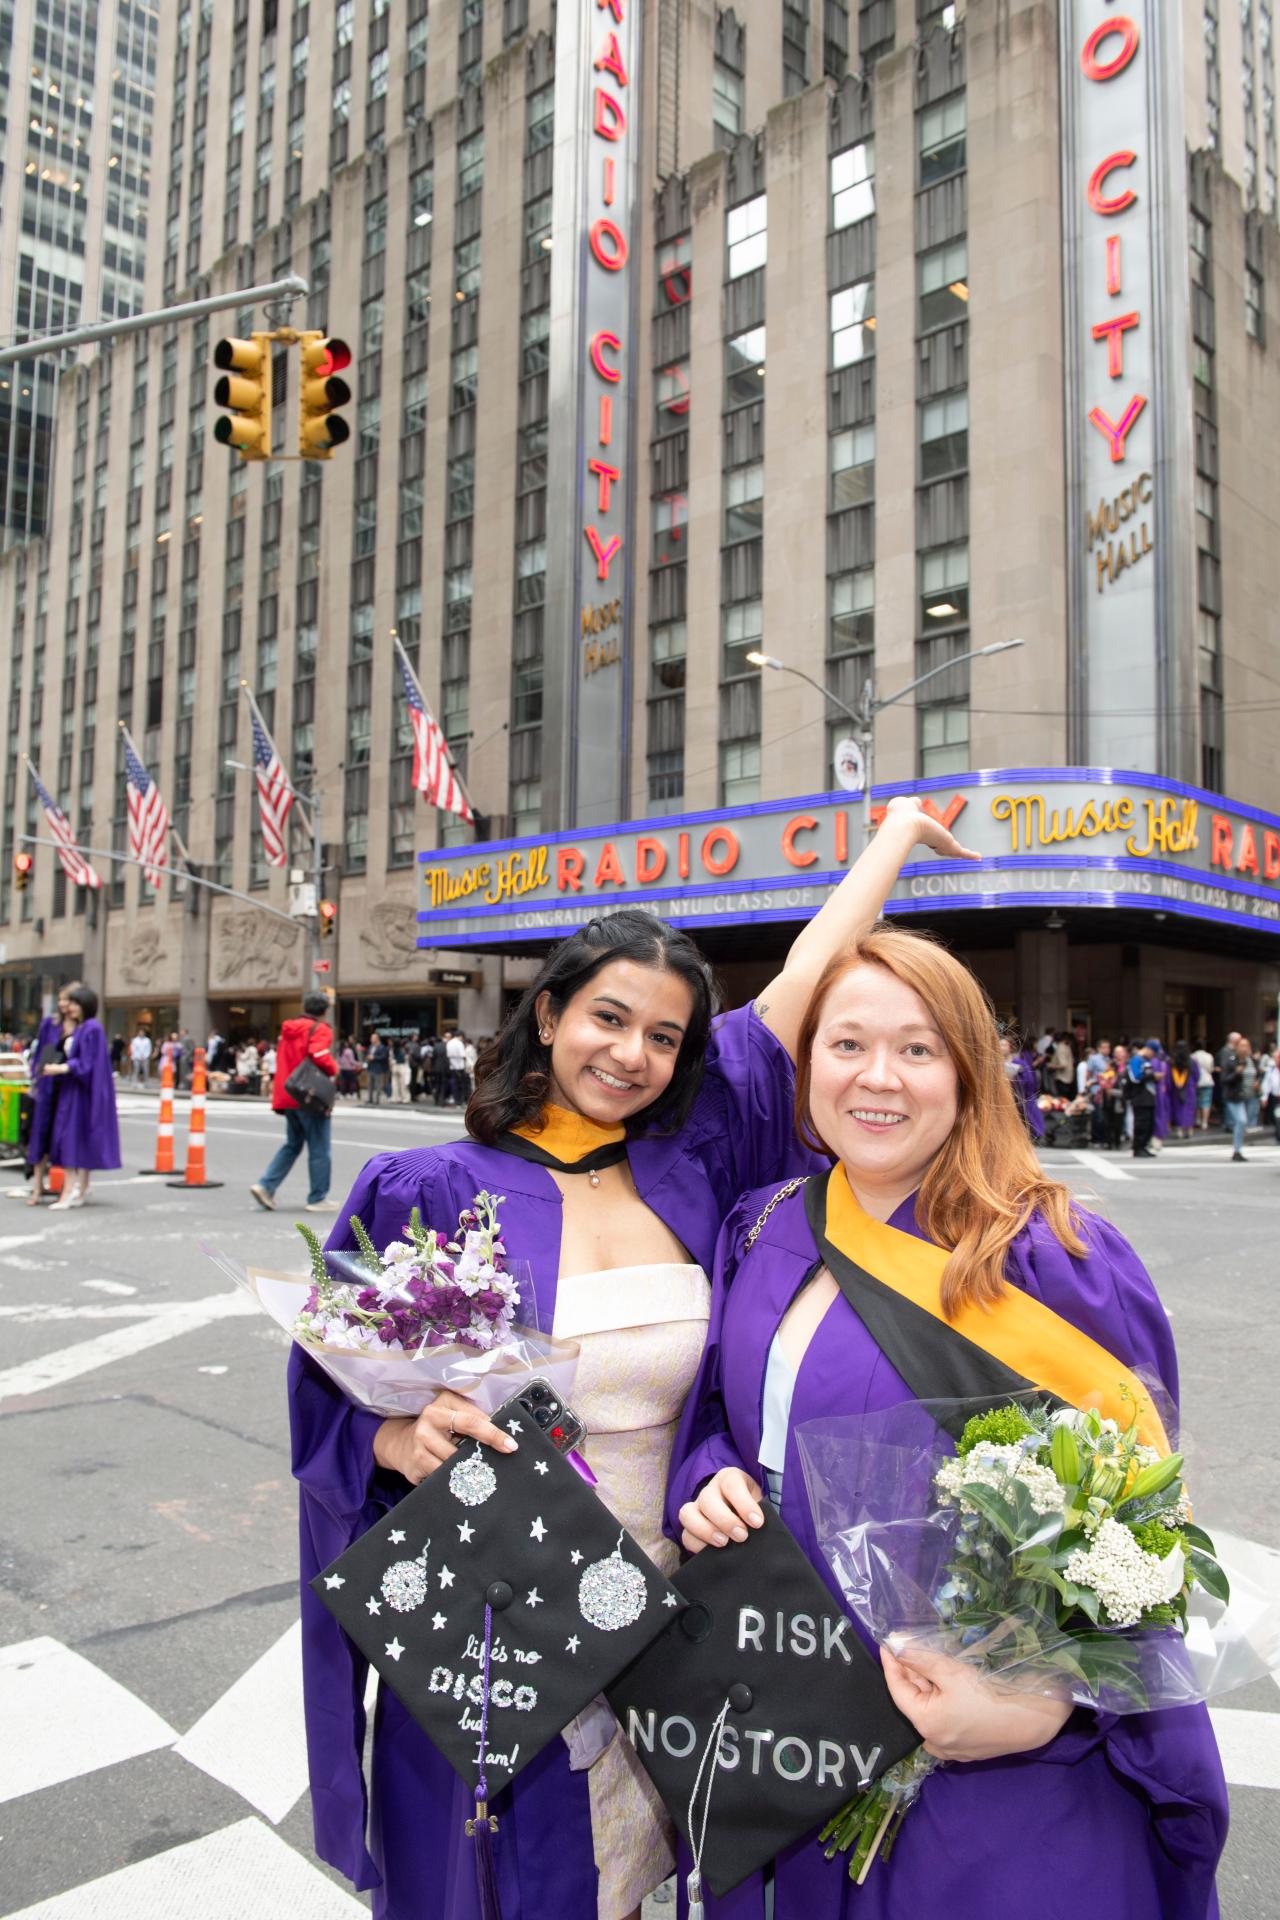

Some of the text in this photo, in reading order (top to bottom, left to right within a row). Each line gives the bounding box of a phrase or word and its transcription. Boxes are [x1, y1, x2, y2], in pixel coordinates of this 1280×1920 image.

[1086, 150, 1148, 464] CITY
[584, 329, 623, 581] CITY
[1096, 522, 1154, 593] HALL
[424, 862, 490, 908] Music
[484, 845, 551, 905] Hall
[557, 826, 741, 892] RADIO
[991, 794, 1136, 852] Music
[1126, 797, 1199, 857] Hall
[669, 896, 702, 917] NYU
[713, 891, 773, 913] CLASS
[786, 888, 812, 906] OF
[513, 1649, 542, 1664] no
[738, 1607, 852, 1664] RISK
[428, 1666, 538, 1712] DISCO
[485, 1743, 520, 1774] am!
[629, 1708, 882, 1791] NO STORY
